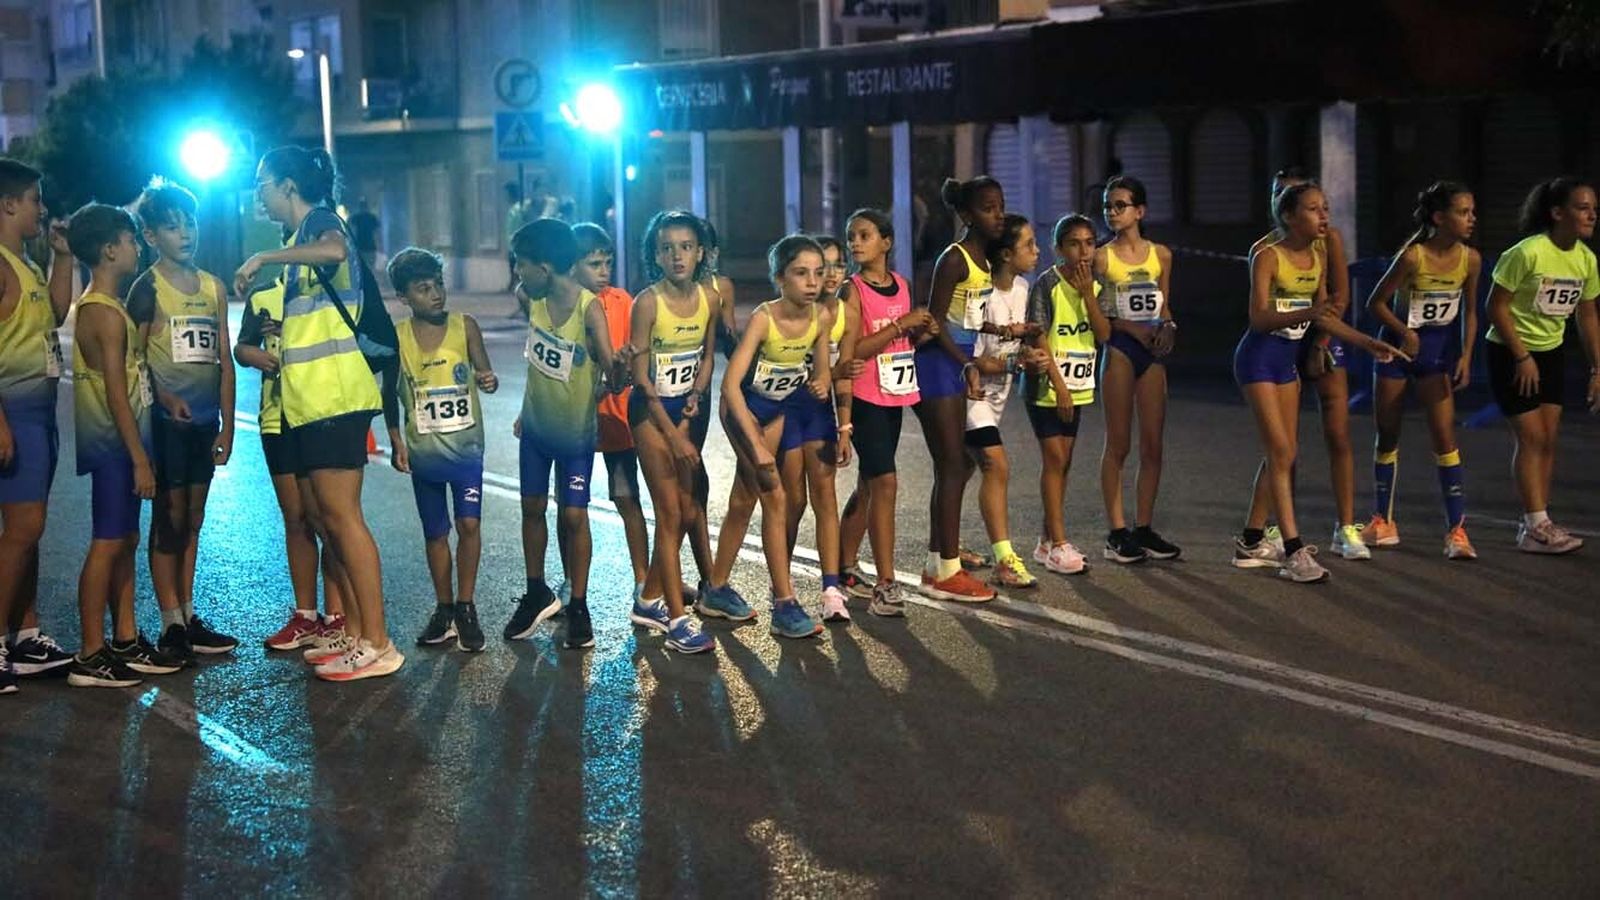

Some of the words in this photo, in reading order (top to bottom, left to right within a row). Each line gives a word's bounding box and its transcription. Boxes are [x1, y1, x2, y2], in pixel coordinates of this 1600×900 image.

[1129, 293, 1157, 312] 65
[1545, 288, 1580, 305] 152
[1422, 302, 1452, 320] 87
[182, 331, 216, 350] 157
[533, 341, 562, 369] 48
[892, 365, 914, 385] 77
[1060, 361, 1093, 379] 108
[763, 375, 805, 392] 124
[424, 398, 469, 420] 138
